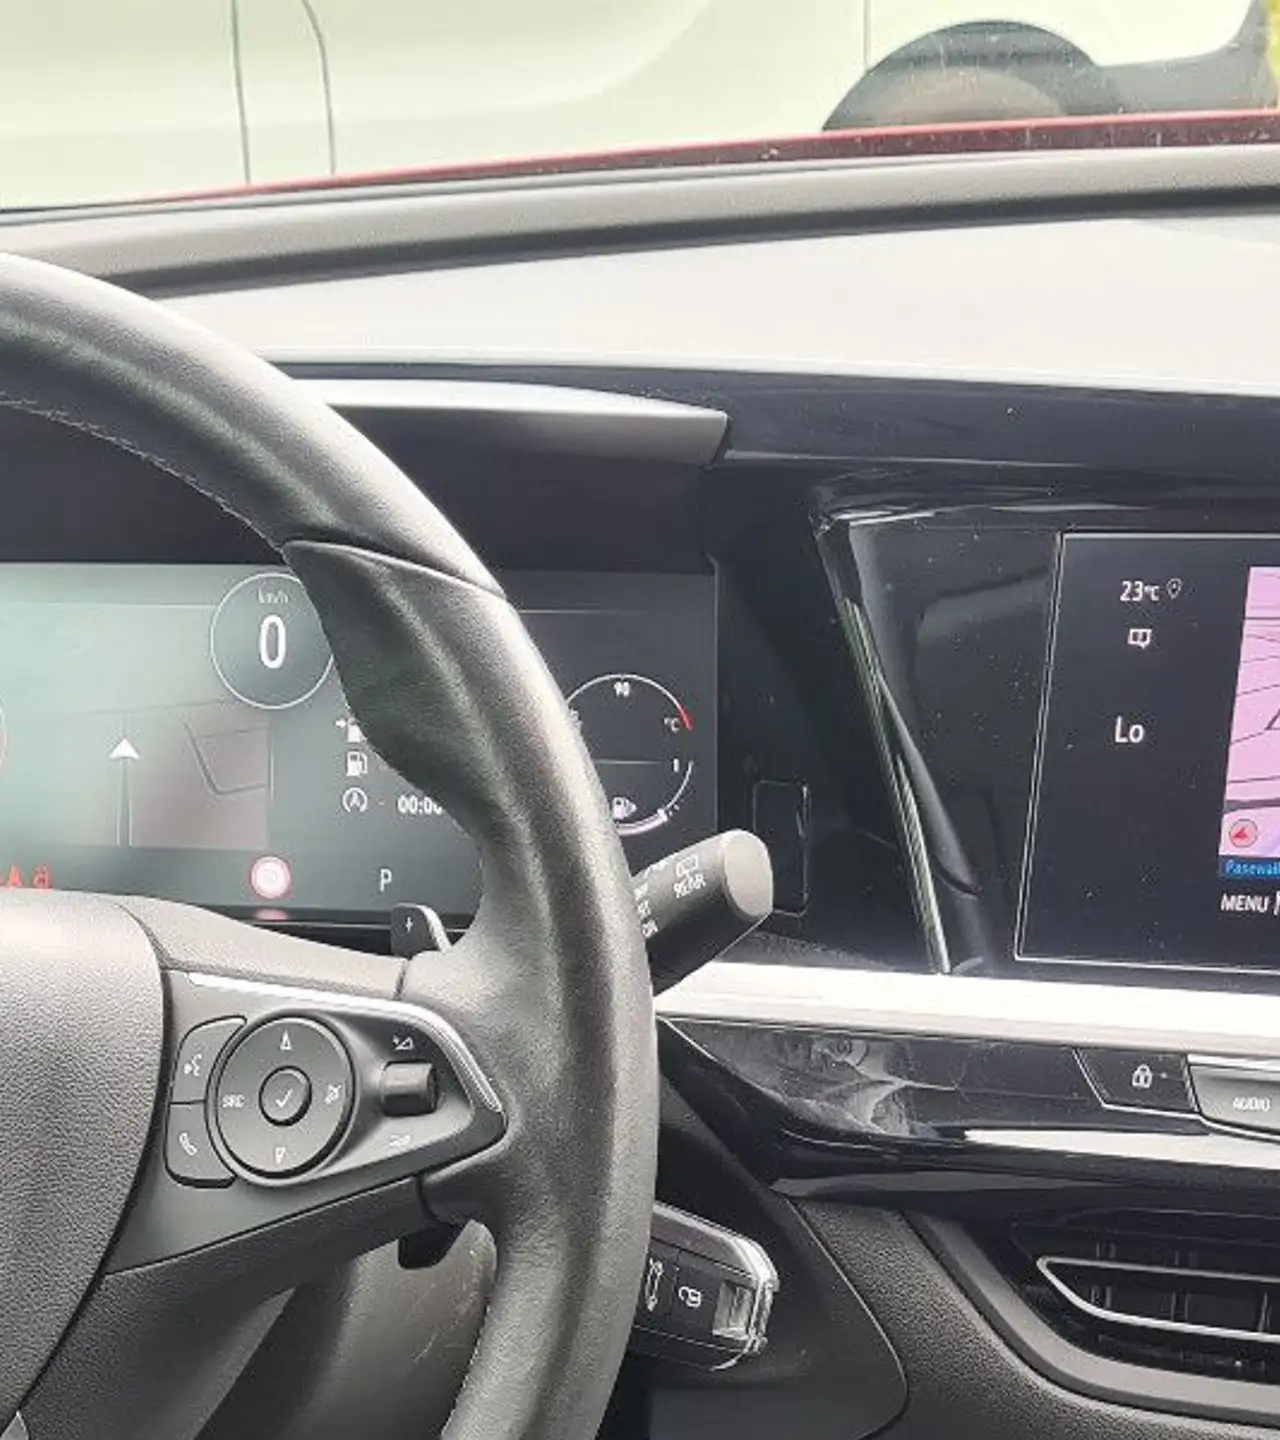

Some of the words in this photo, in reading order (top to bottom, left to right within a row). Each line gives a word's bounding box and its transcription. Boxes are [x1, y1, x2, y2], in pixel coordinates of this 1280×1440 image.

[260, 614, 287, 669] 0
[1115, 715, 1144, 743] Lo
[379, 868, 393, 891] P
[1220, 893, 1269, 913] MENU
[1232, 1096, 1270, 1113] AUDIO
